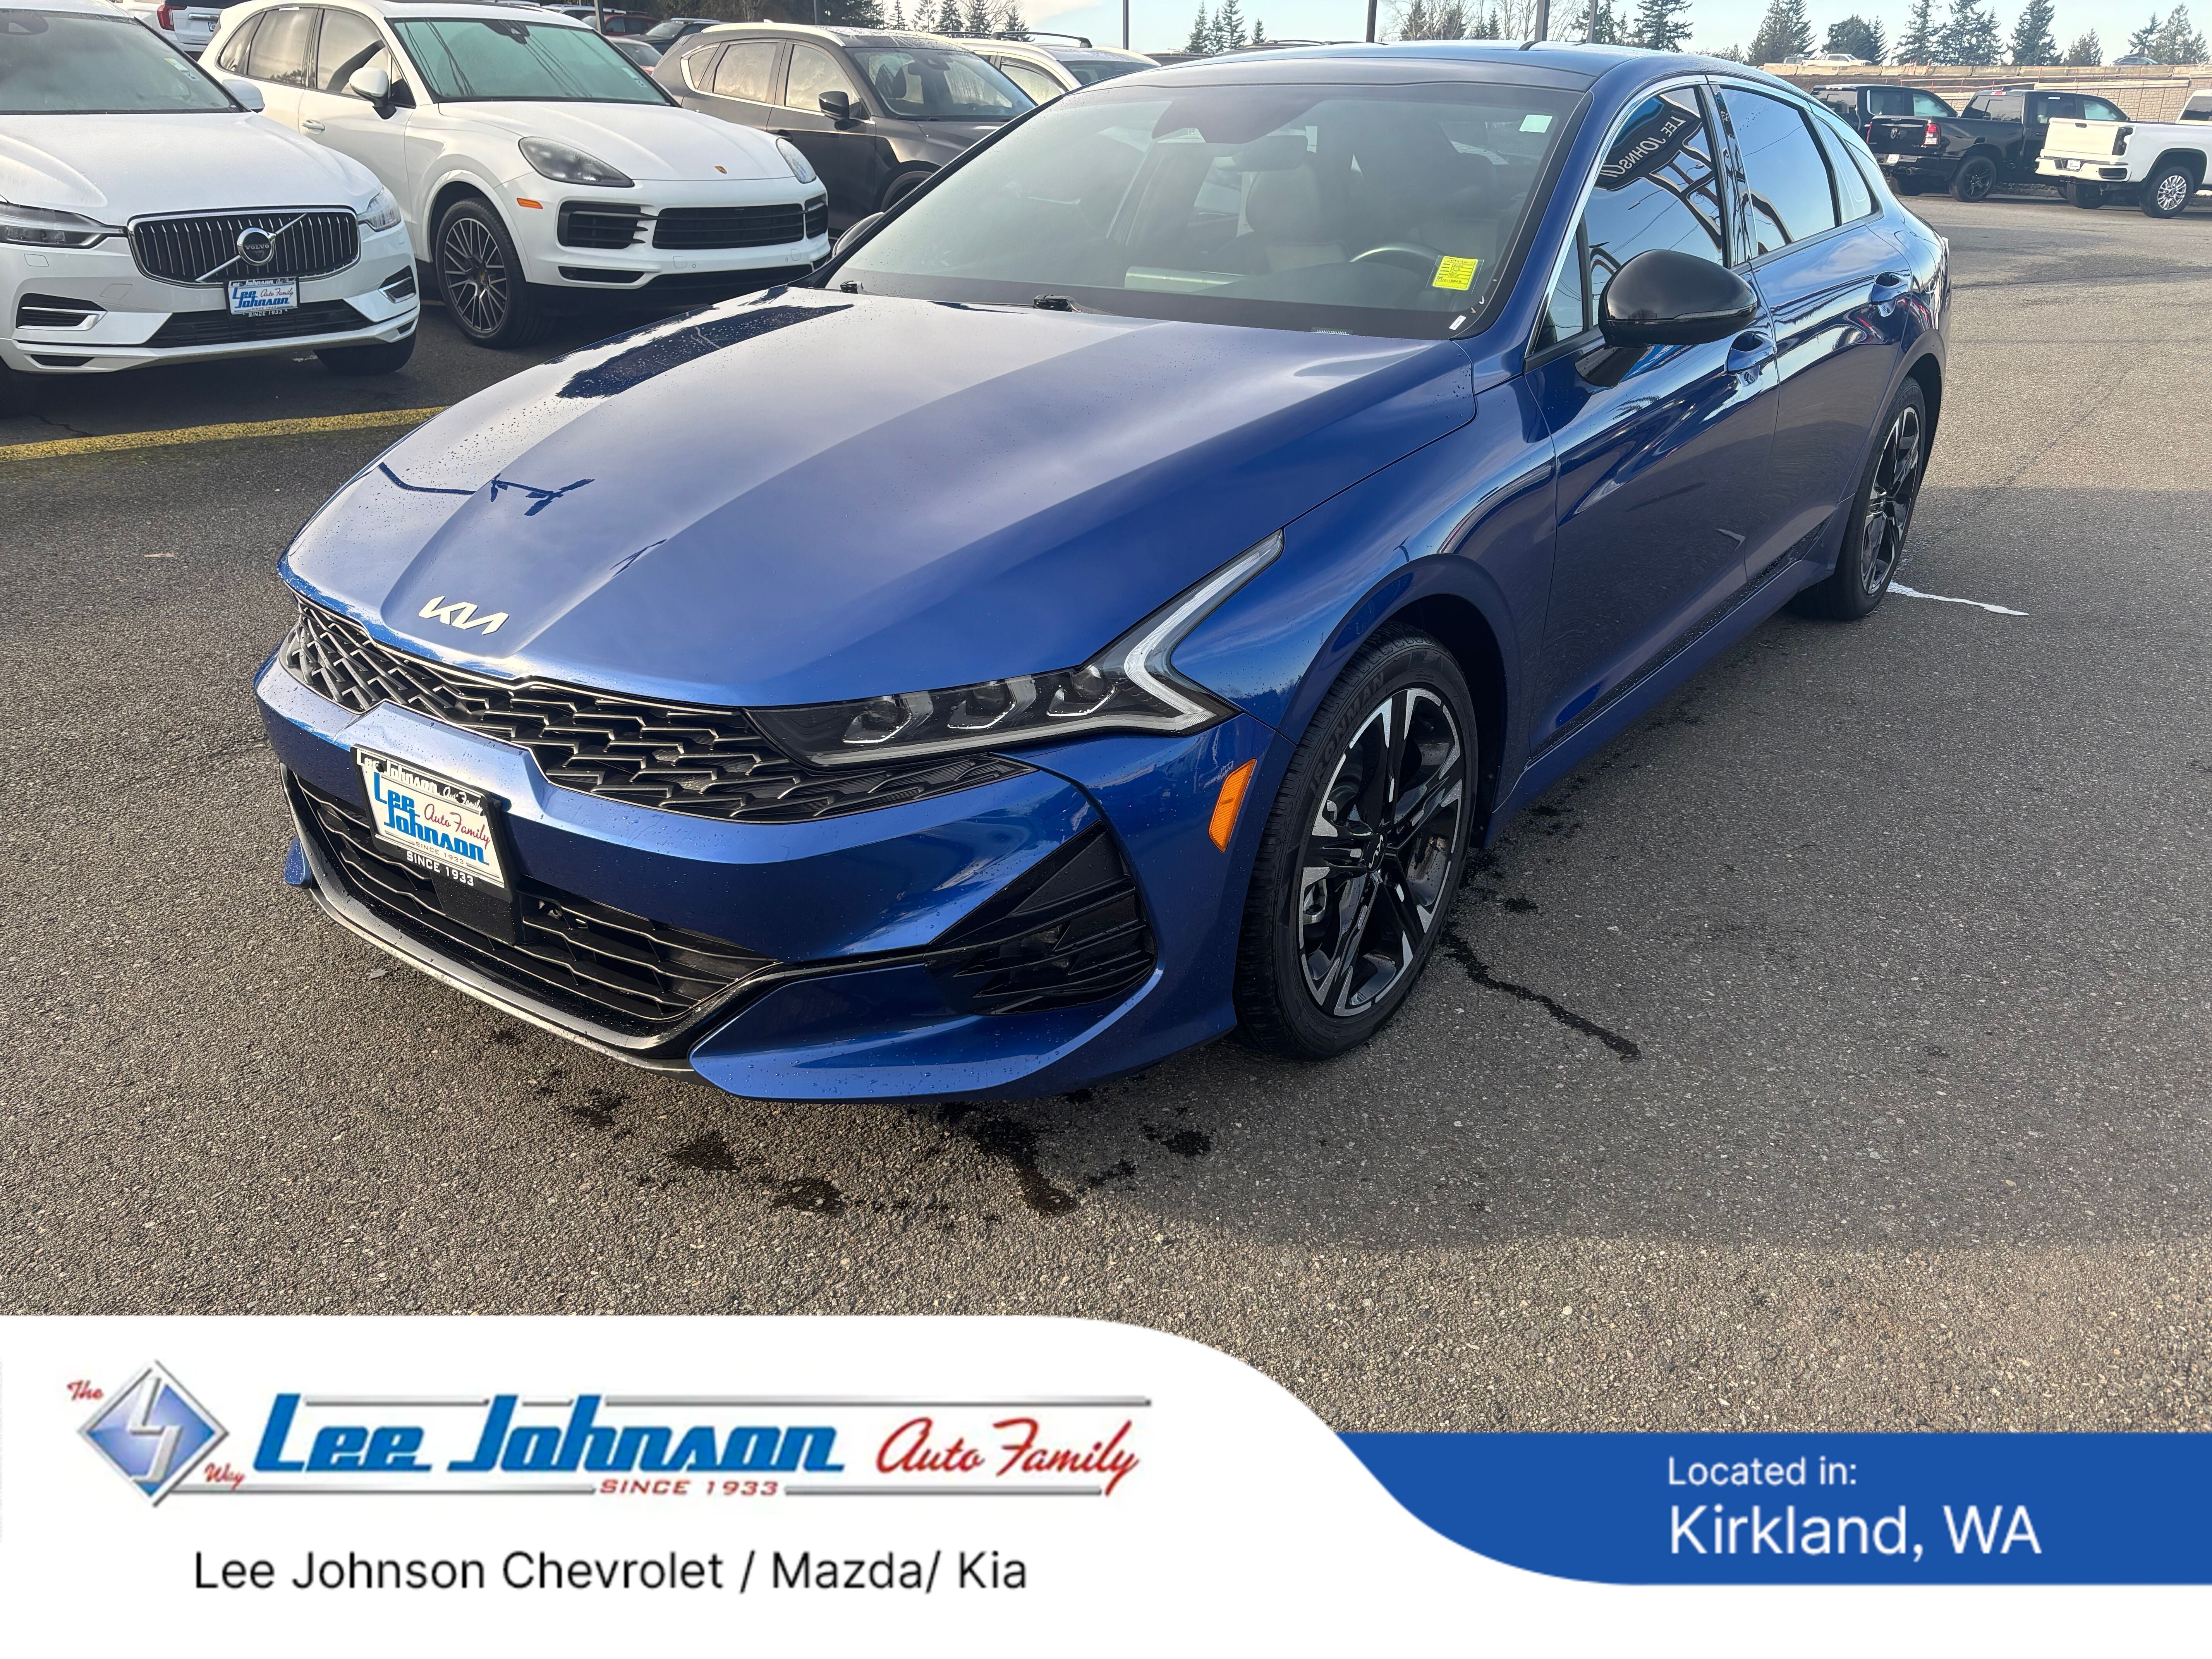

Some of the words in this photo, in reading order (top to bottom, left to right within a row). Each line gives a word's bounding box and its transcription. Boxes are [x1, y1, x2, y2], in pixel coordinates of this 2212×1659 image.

[233, 287, 258, 299] Lee
[234, 294, 290, 308] Johnson
[260, 289, 274, 297] Auto
[275, 287, 293, 297] Family
[419, 596, 509, 635] KIA
[374, 771, 420, 818] Lee
[385, 759, 440, 795] Johnson
[383, 804, 489, 866] Johnson
[424, 803, 451, 827] Auto
[450, 812, 491, 850] Family
[407, 850, 441, 873] SINCE
[445, 866, 474, 886] 1933
[415, 841, 440, 855] SINCE
[443, 852, 464, 864] 1933
